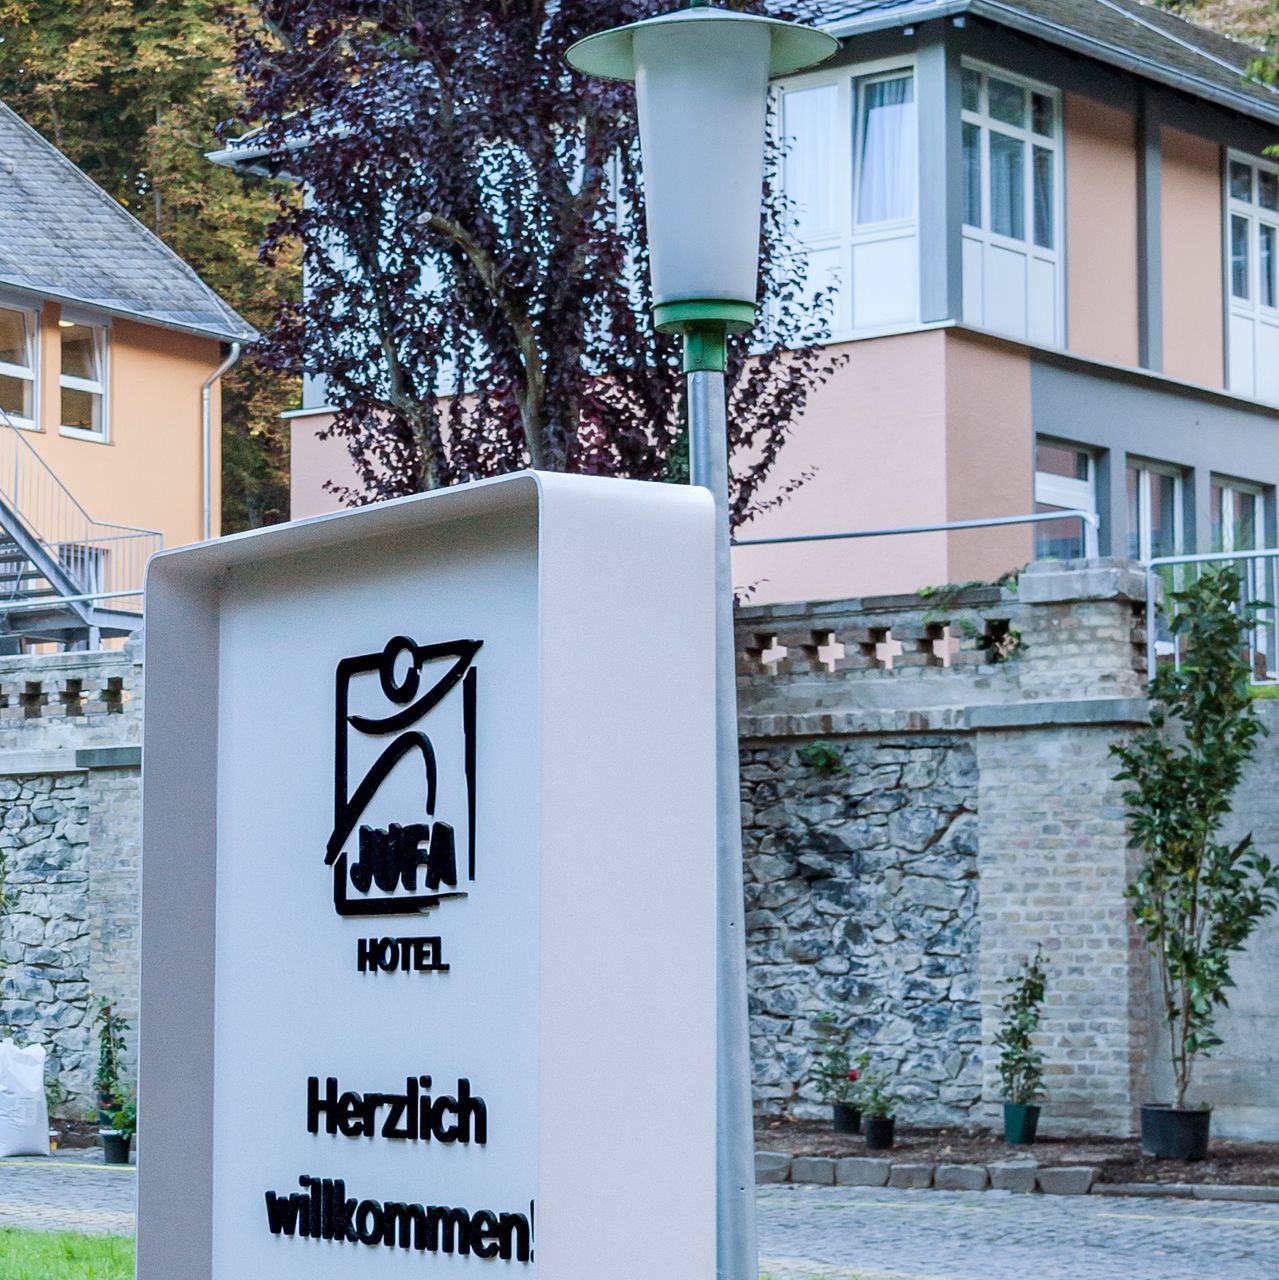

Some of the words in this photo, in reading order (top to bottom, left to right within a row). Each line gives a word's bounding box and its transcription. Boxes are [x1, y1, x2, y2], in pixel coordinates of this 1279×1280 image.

[350, 821, 458, 893] JUFA
[358, 936, 450, 972] HOTEL
[307, 1075, 488, 1145] Herzlich
